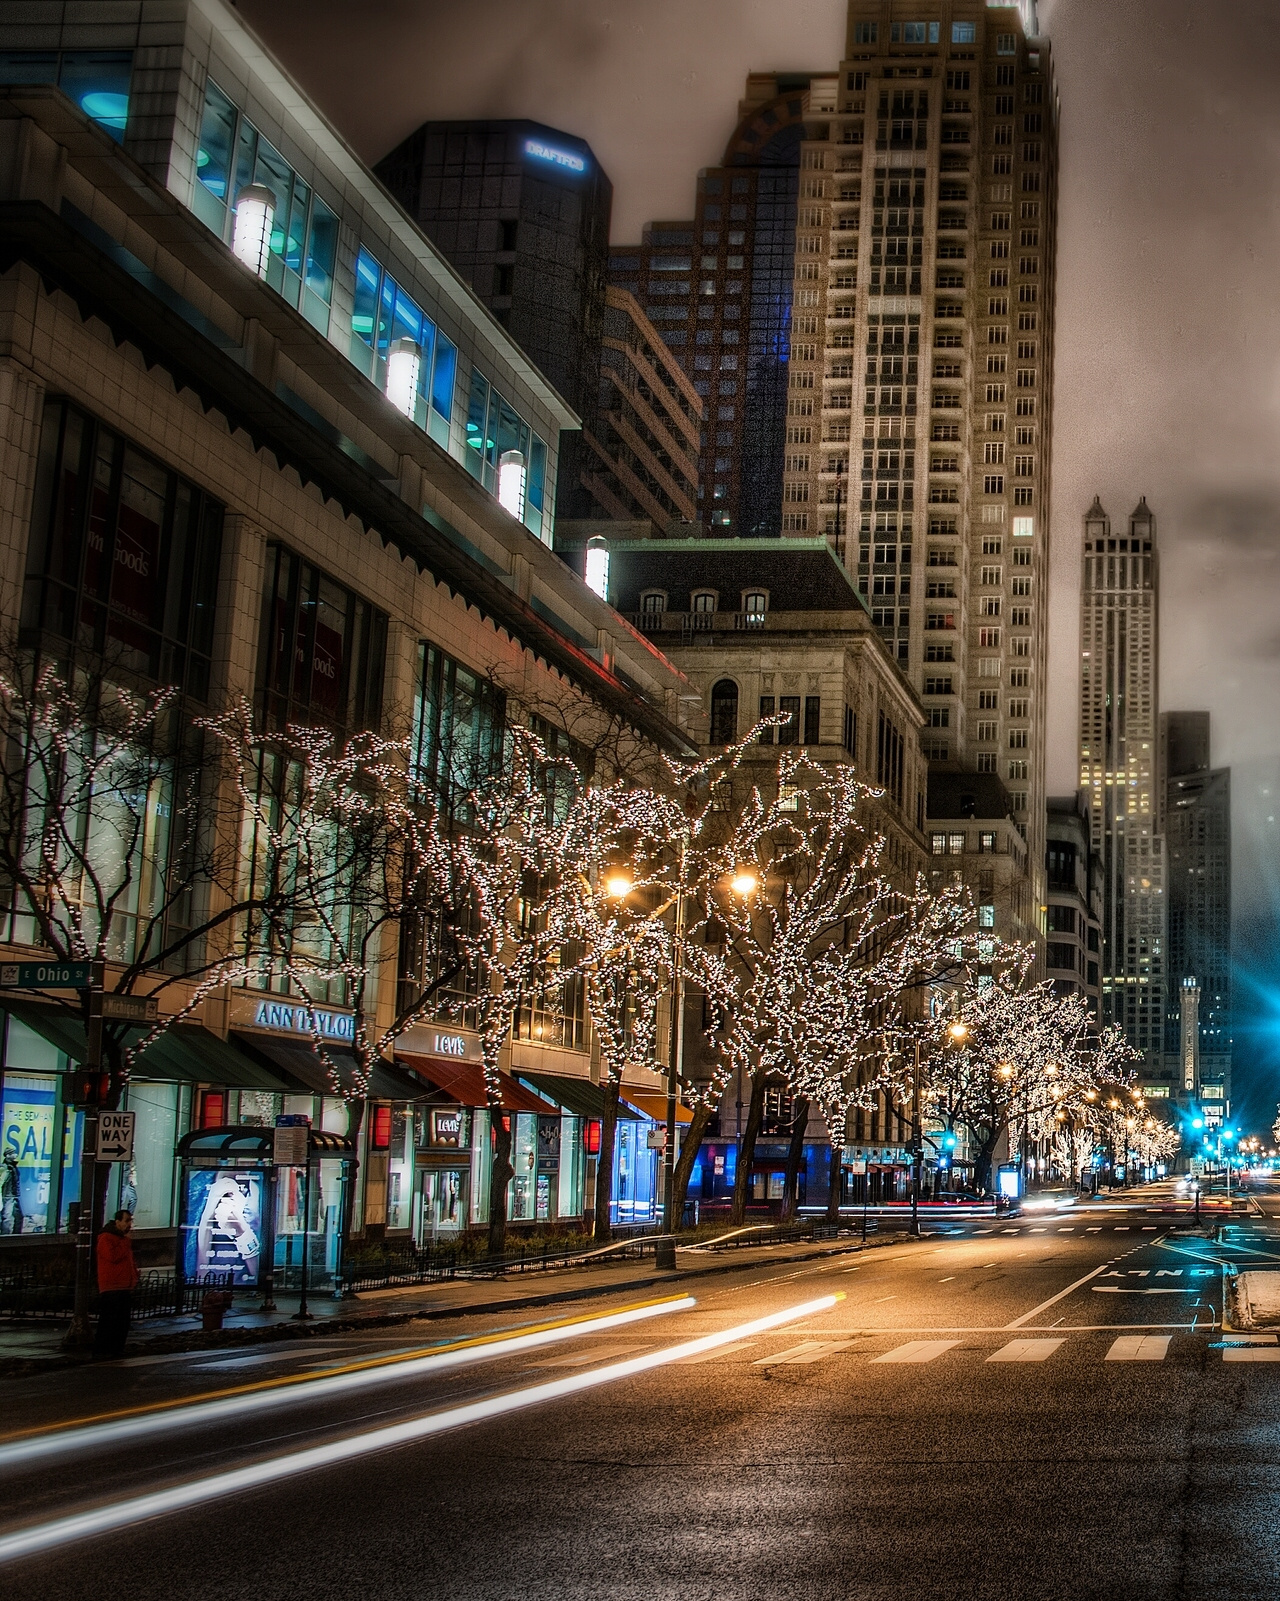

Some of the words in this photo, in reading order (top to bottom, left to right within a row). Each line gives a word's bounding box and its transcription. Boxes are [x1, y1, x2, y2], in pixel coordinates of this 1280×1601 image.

[24, 970, 30, 978] E
[37, 967, 70, 981] Ohio
[257, 1003, 294, 1028] ANN
[298, 1009, 355, 1037] TYLO
[103, 1116, 130, 1128] ONE
[101, 1130, 131, 1141] WAY
